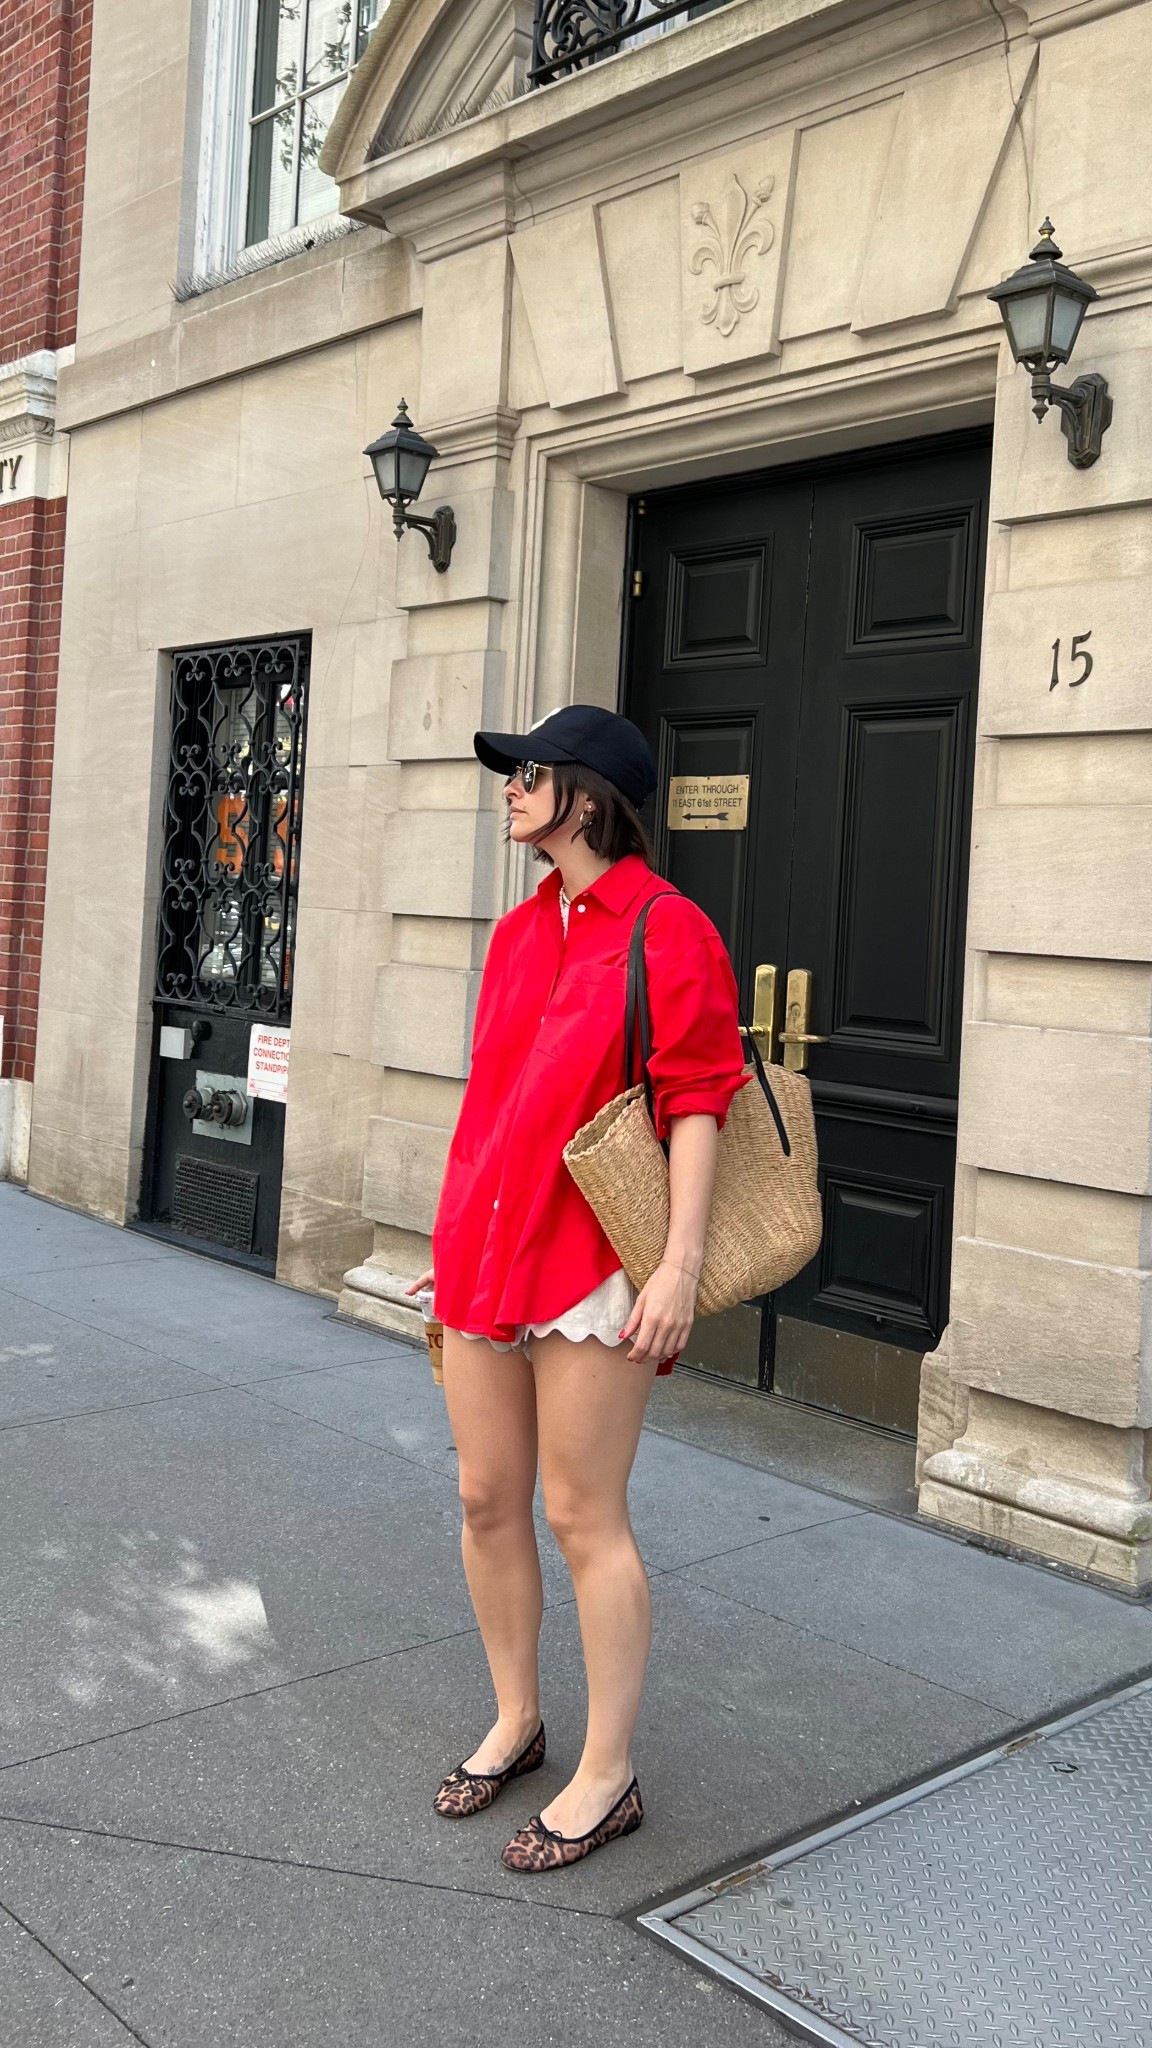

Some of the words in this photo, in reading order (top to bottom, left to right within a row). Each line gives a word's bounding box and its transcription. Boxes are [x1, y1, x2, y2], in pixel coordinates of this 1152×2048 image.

[1049, 630, 1093, 692] 15
[676, 785, 699, 795] ENTER
[702, 784, 739, 794] THROUGH
[678, 798, 696, 808] EAST
[697, 798, 712, 808] 61st
[714, 797, 743, 808] STREET
[258, 1034, 272, 1046] FIRE
